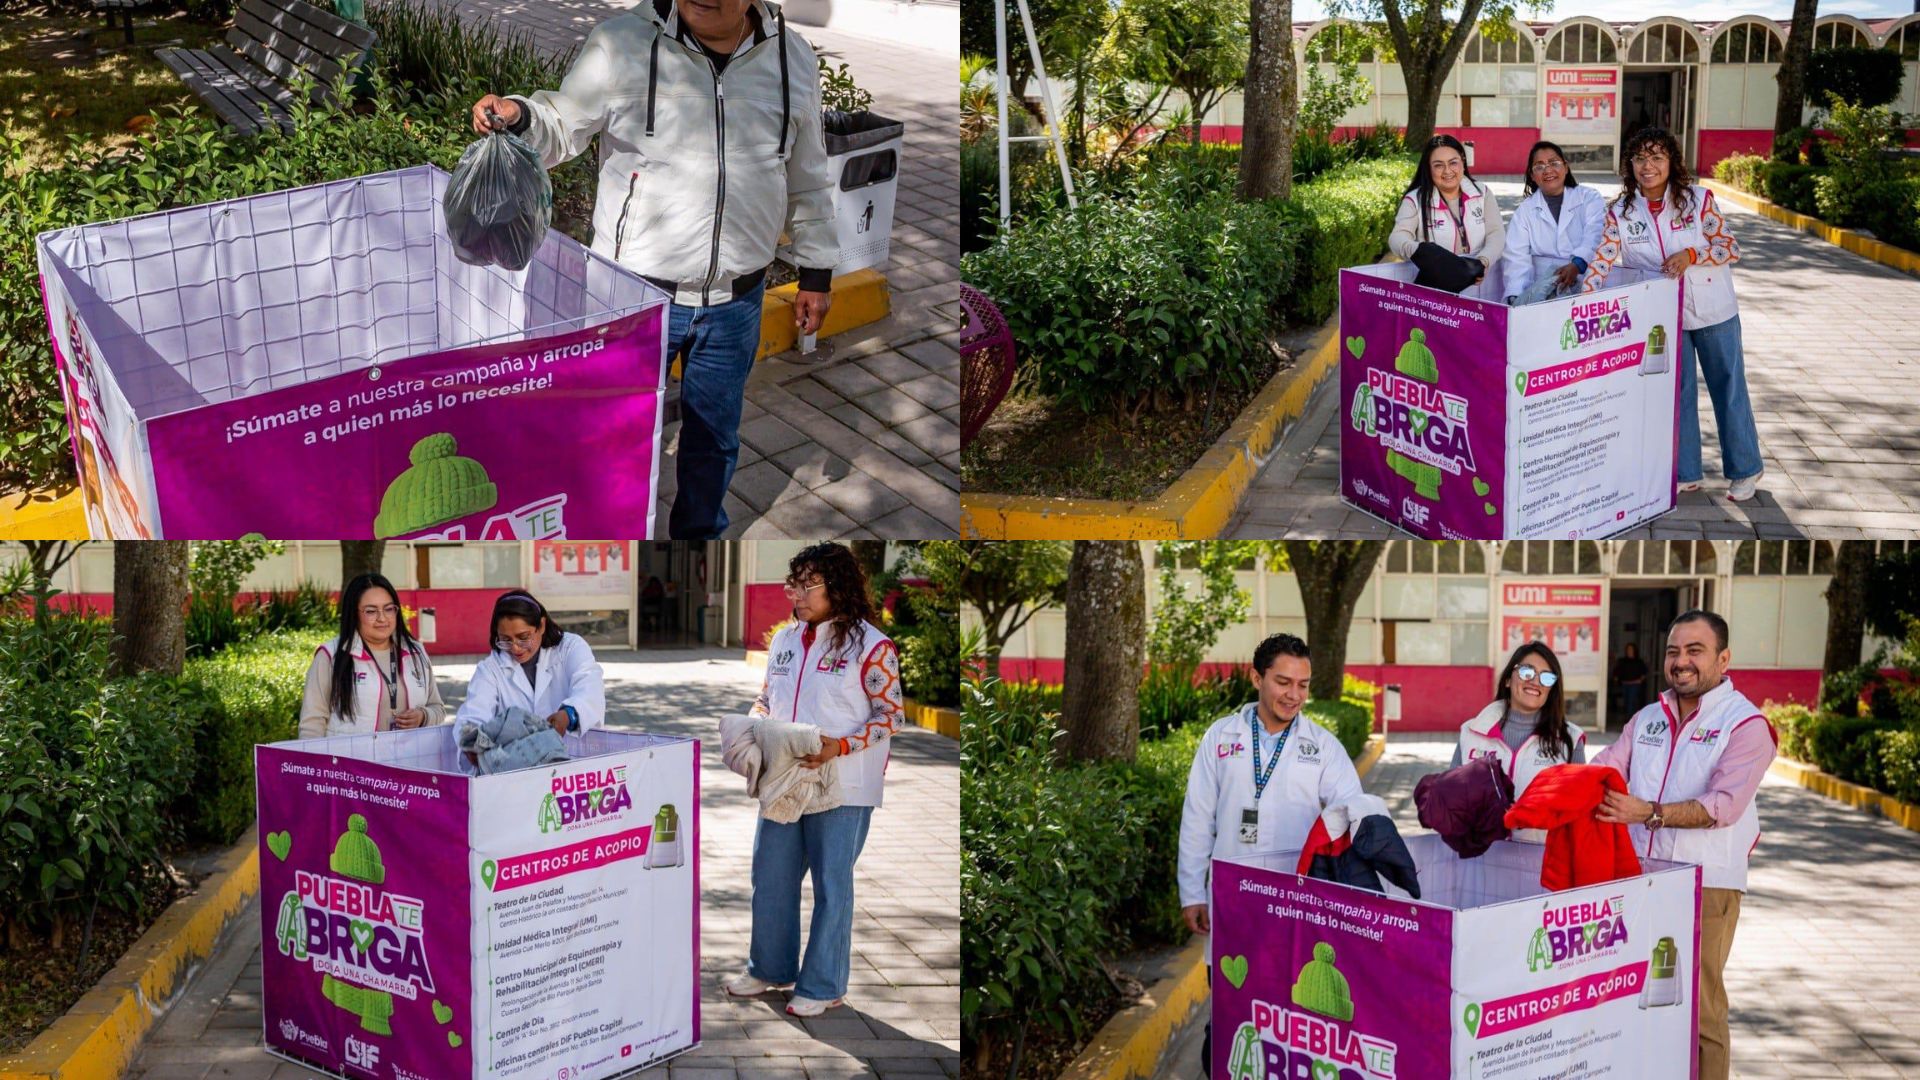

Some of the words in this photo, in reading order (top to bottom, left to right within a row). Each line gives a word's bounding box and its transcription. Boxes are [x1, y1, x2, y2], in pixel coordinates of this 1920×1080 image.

[1359, 283, 1386, 296] ¡Súmate
[1392, 291, 1416, 304] nuestra
[1418, 297, 1451, 313] campaña
[1452, 306, 1457, 315] y
[1458, 308, 1484, 321] arropa
[1384, 301, 1403, 313] quien
[1404, 305, 1420, 317] más
[1420, 309, 1427, 319] lo
[1428, 314, 1460, 328] necesite!
[1572, 299, 1620, 320] PUEBLA
[1530, 366, 1583, 388] CENTROS
[1584, 362, 1597, 374] DE
[1602, 350, 1638, 370] ACOPIO
[226, 401, 323, 443] ¡Súmate
[329, 399, 341, 414] a
[347, 378, 425, 409] nuestra
[431, 355, 524, 389] campaña
[528, 353, 539, 372] y
[543, 337, 605, 364] arropa
[1368, 369, 1449, 418] PUEBLA
[1449, 402, 1465, 420] TE
[1557, 390, 1578, 401] Ciudad
[303, 431, 317, 445] a
[322, 411, 384, 443] quien
[390, 400, 434, 422] más
[438, 390, 457, 410] lo
[461, 373, 554, 404] necesite!
[1523, 457, 1543, 469] Centro
[526, 509, 559, 538] TE
[1522, 499, 1541, 511] Centro
[1507, 586, 1547, 603] UMI
[281, 762, 315, 776] ¡Súmate
[324, 769, 355, 782] nuestra
[356, 776, 399, 791] campaña
[399, 784, 407, 794] y
[408, 784, 440, 799] arropa
[306, 783, 312, 792] a
[313, 782, 339, 796] quien
[340, 787, 359, 800] más
[360, 789, 368, 801] lo
[370, 794, 409, 810] necesite!
[552, 768, 616, 795] PUEBLA
[500, 855, 569, 881] CENTROS
[572, 849, 590, 864] DE
[594, 836, 642, 860] ACOPIO
[298, 873, 398, 928] PUEBLA
[398, 905, 419, 926] TE
[494, 899, 518, 911] Teatro
[519, 895, 529, 905] de
[530, 893, 537, 901] la
[537, 885, 564, 899] Ciudad
[1239, 879, 1278, 897] ¡Súmate
[1279, 888, 1285, 899] a
[1287, 889, 1323, 907] nuestra
[1324, 898, 1372, 920] campaña
[1372, 912, 1381, 925] y
[1383, 913, 1419, 932] arropa
[1543, 899, 1612, 929] PUEBLA
[1613, 900, 1624, 911] TE
[277, 892, 434, 990] ABRIGA
[494, 935, 522, 951] Unidad
[523, 927, 550, 944] Médica
[552, 920, 579, 936] Integral
[579, 914, 598, 929] (UMI)
[1267, 903, 1274, 914] a
[1275, 903, 1303, 920] quien
[1305, 909, 1327, 926] más
[1328, 914, 1338, 929] lo
[1340, 920, 1383, 942] necesite!
[343, 967, 360, 979] UNA
[363, 974, 415, 995] CHAMARRA!
[495, 972, 521, 985] Centro
[523, 960, 558, 977] Municipal
[558, 956, 567, 964] de
[568, 940, 616, 963] Equinoterapia
[495, 974, 549, 998] Rehabilitación
[550, 963, 577, 980] Integral
[578, 955, 605, 972] (CMERI)
[1485, 995, 1559, 1026] CENTROS
[1563, 987, 1581, 1005] DE
[1587, 972, 1637, 1000] ACOPIO
[300, 1030, 328, 1049] Puebla
[495, 1053, 527, 1070] Oficinas
[527, 1040, 559, 1059] centrales
[560, 1033, 573, 1046] DIF
[573, 1026, 599, 1041] Puebla
[599, 1016, 624, 1033] Capital
[496, 1026, 521, 1041] Centro
[521, 1022, 531, 1031] de
[532, 1016, 545, 1028] Día
[1255, 1003, 1368, 1071] PUEBLA
[1368, 1048, 1392, 1071] TE
[1477, 1045, 1502, 1059] Teatro
[1503, 1041, 1515, 1052] de
[1515, 1038, 1523, 1048] la
[1524, 1029, 1552, 1045] Ciudad
[1568, 1060, 1588, 1075] (UMI)
